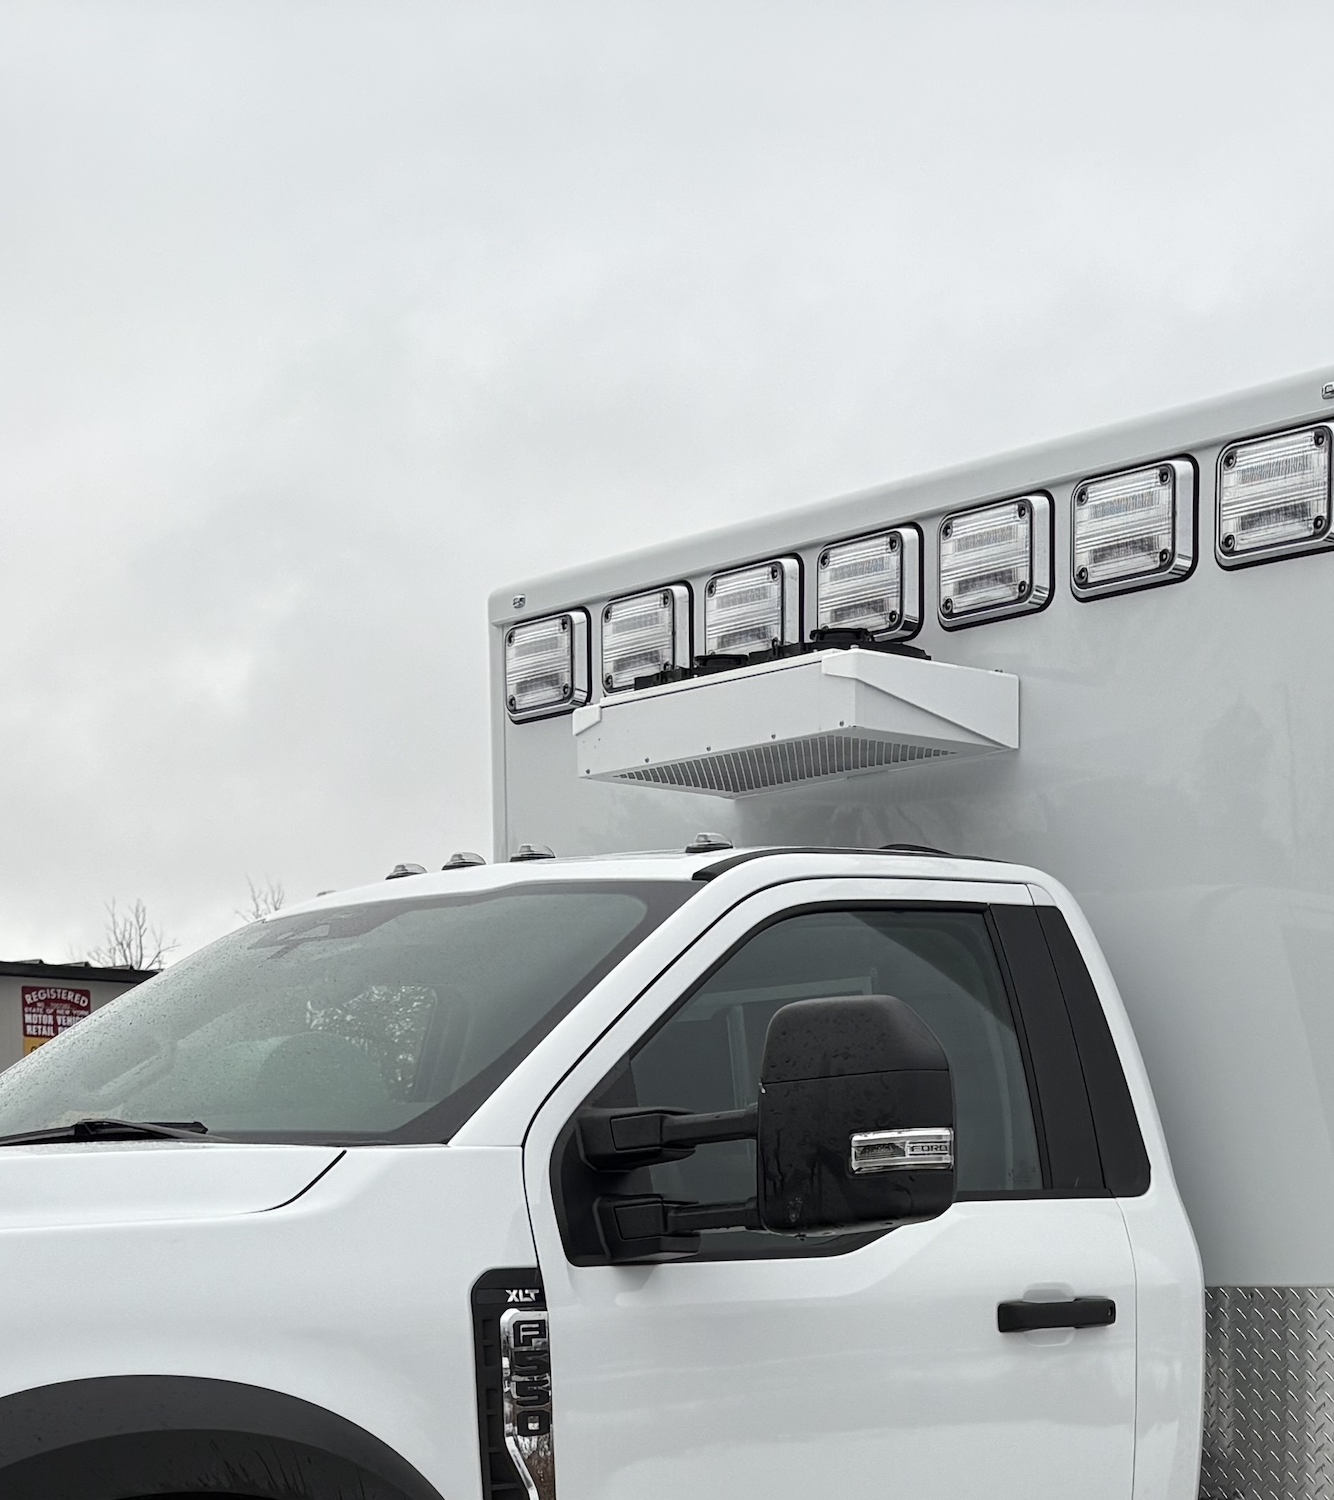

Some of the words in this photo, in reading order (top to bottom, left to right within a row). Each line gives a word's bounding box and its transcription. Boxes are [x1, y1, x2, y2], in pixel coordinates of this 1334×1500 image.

[25, 988, 88, 1007] REGISTERED
[25, 1014, 53, 1024] MOTOR
[26, 1025, 55, 1036] RETAIL
[505, 1289, 540, 1302] XLT
